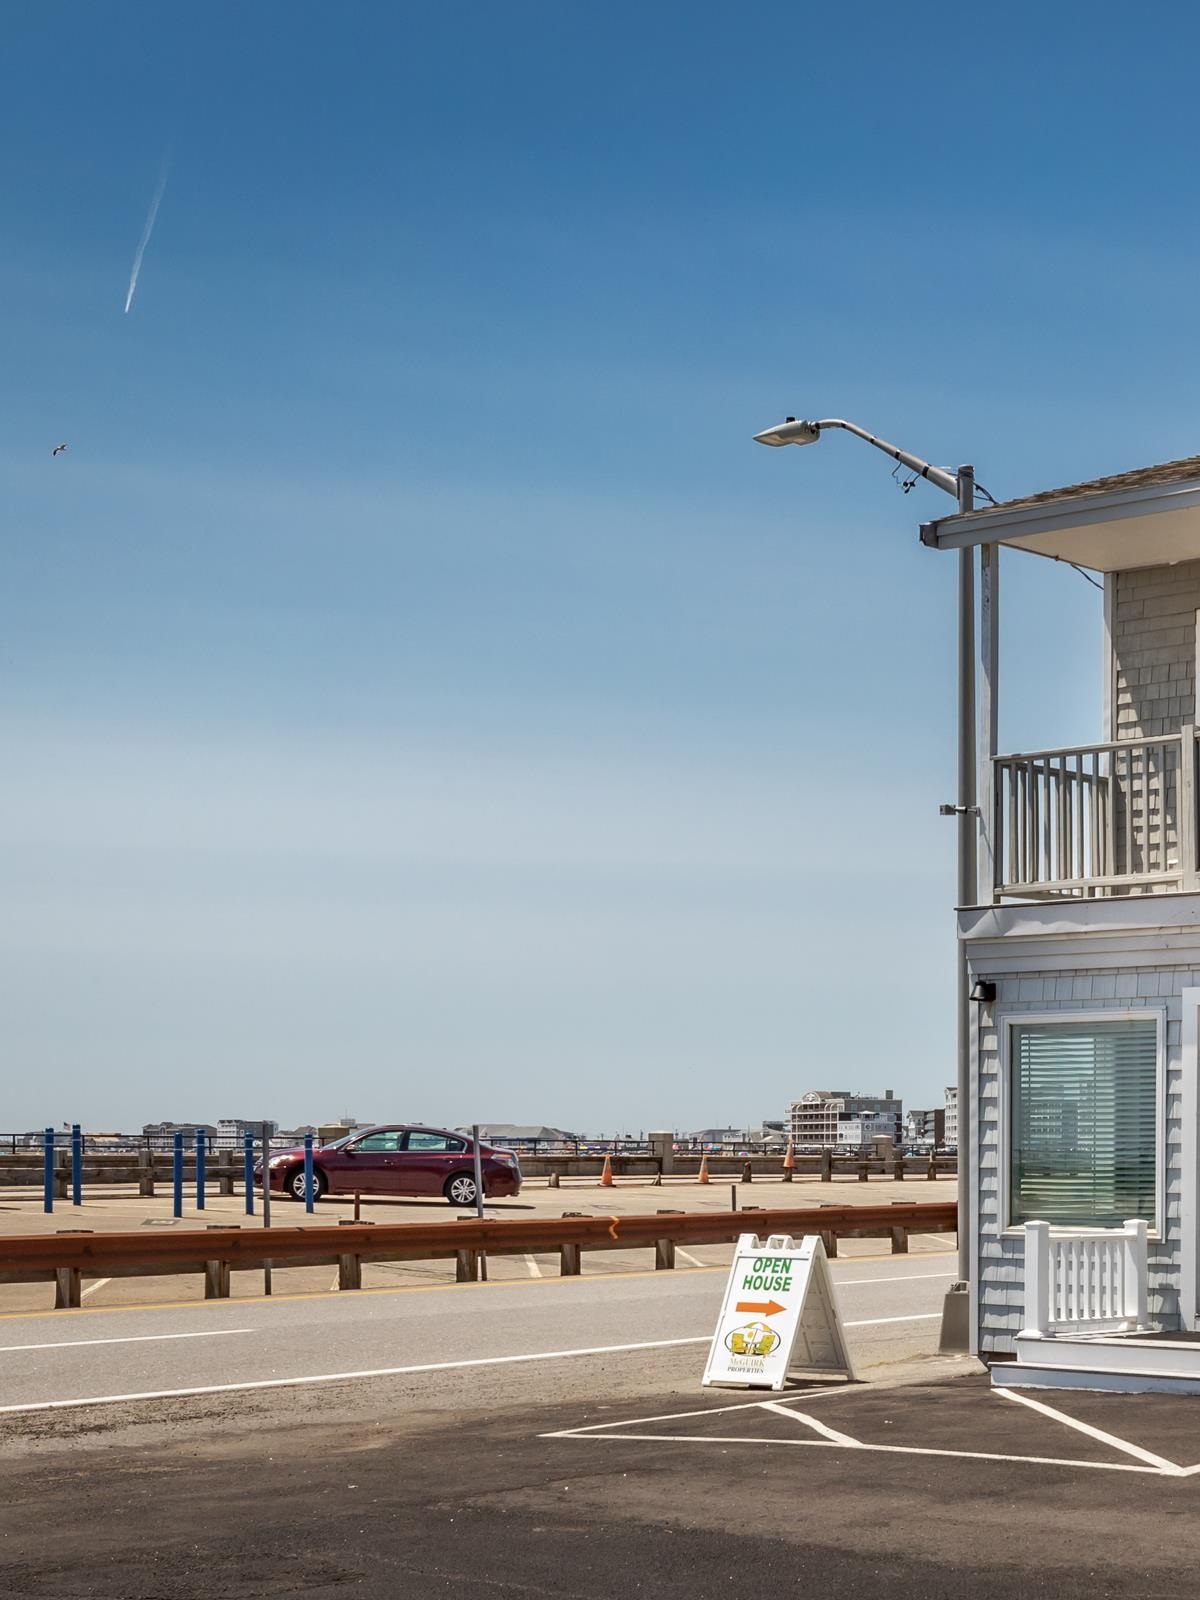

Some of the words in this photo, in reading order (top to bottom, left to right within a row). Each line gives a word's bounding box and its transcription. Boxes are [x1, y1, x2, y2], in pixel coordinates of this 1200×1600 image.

[752, 1257, 793, 1274] OPEN
[741, 1274, 793, 1292] HOUSE
[727, 1366, 764, 1374] PROPERTIES
